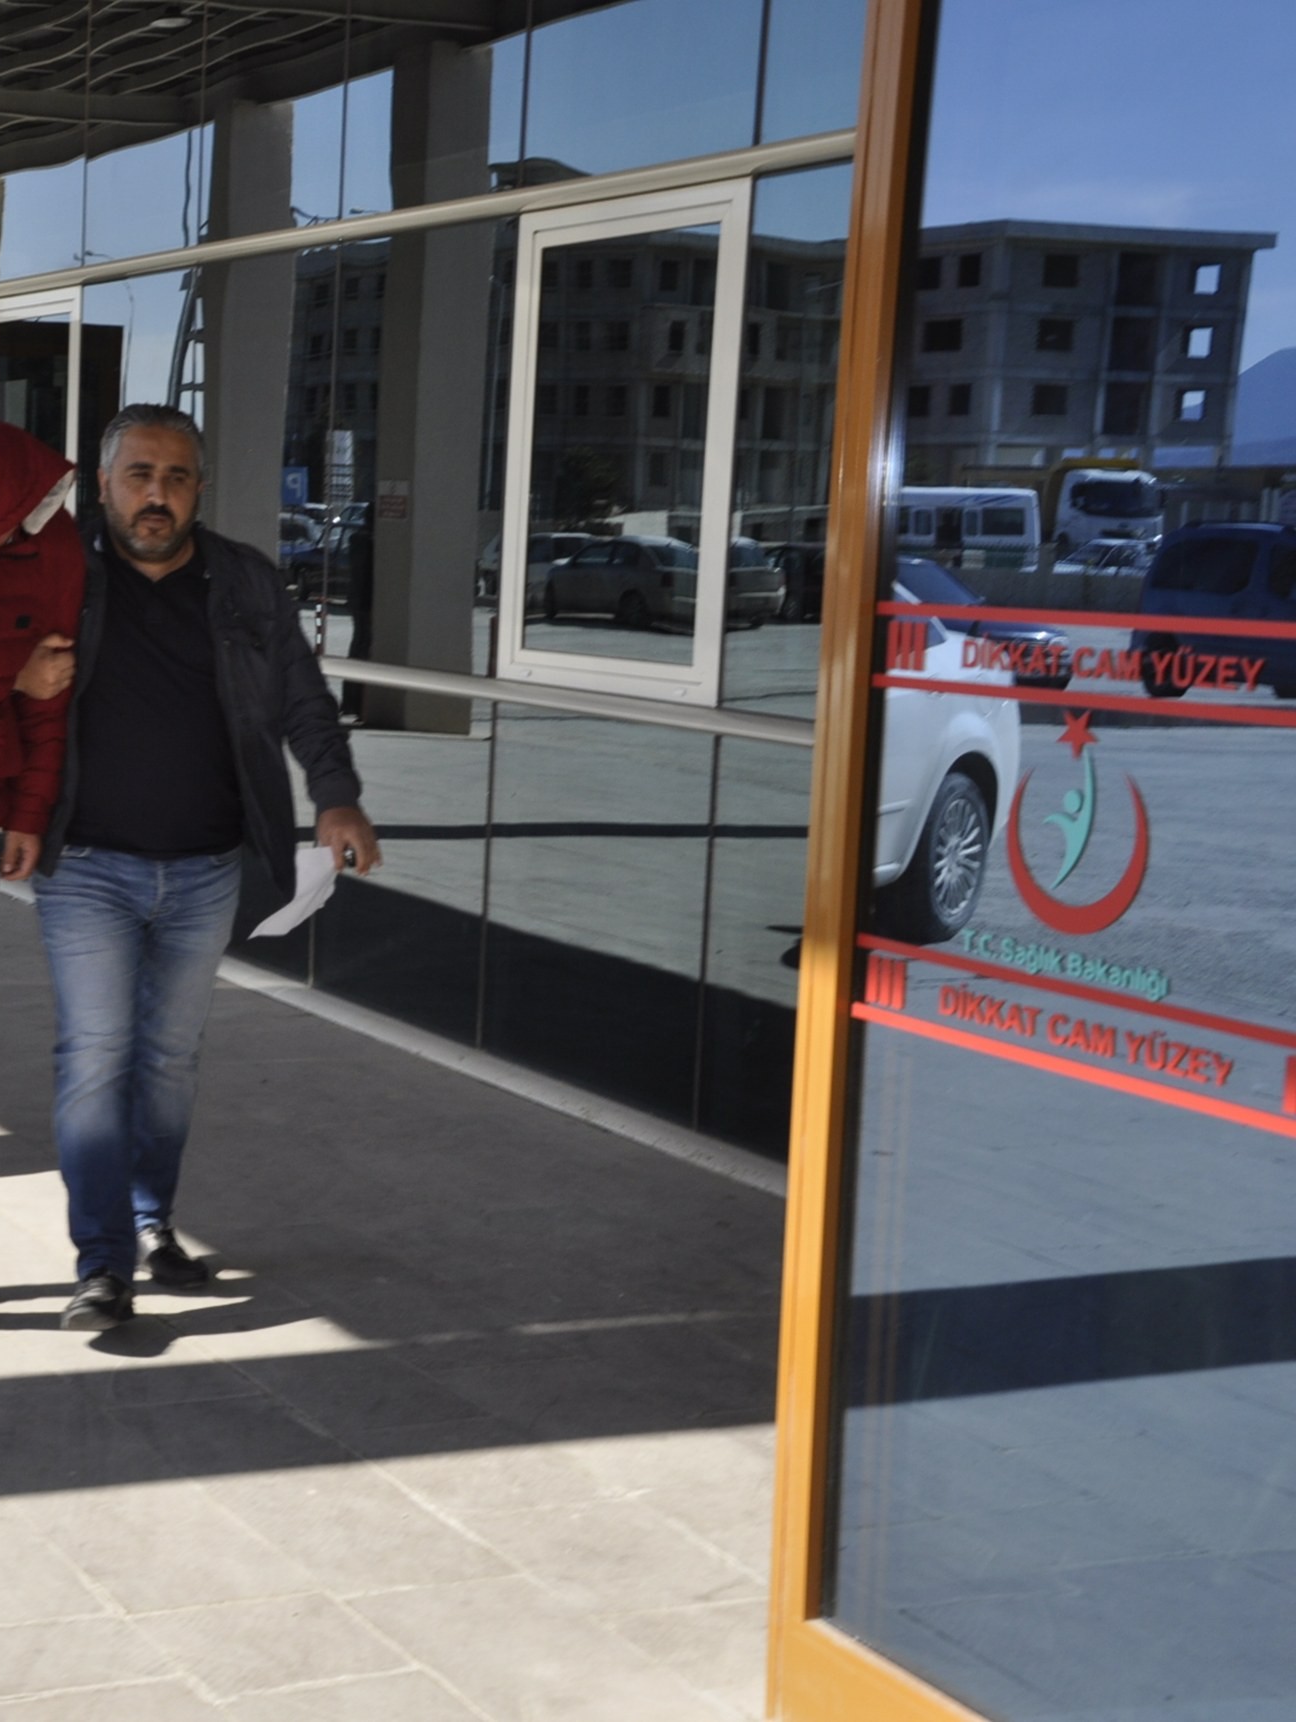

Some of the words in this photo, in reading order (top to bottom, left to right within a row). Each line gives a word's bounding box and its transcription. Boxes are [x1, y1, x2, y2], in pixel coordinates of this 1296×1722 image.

[962, 633, 1062, 678] DİKKAT
[1071, 646, 1141, 681] CAM
[1151, 645, 1266, 692] YÜZEY
[961, 928, 998, 959] T.C.
[1001, 936, 1064, 975] Sağlık
[938, 983, 1042, 1038] DİKKAT
[1047, 1013, 1118, 1059] CAM
[1125, 1031, 1235, 1088] YÜZEY
